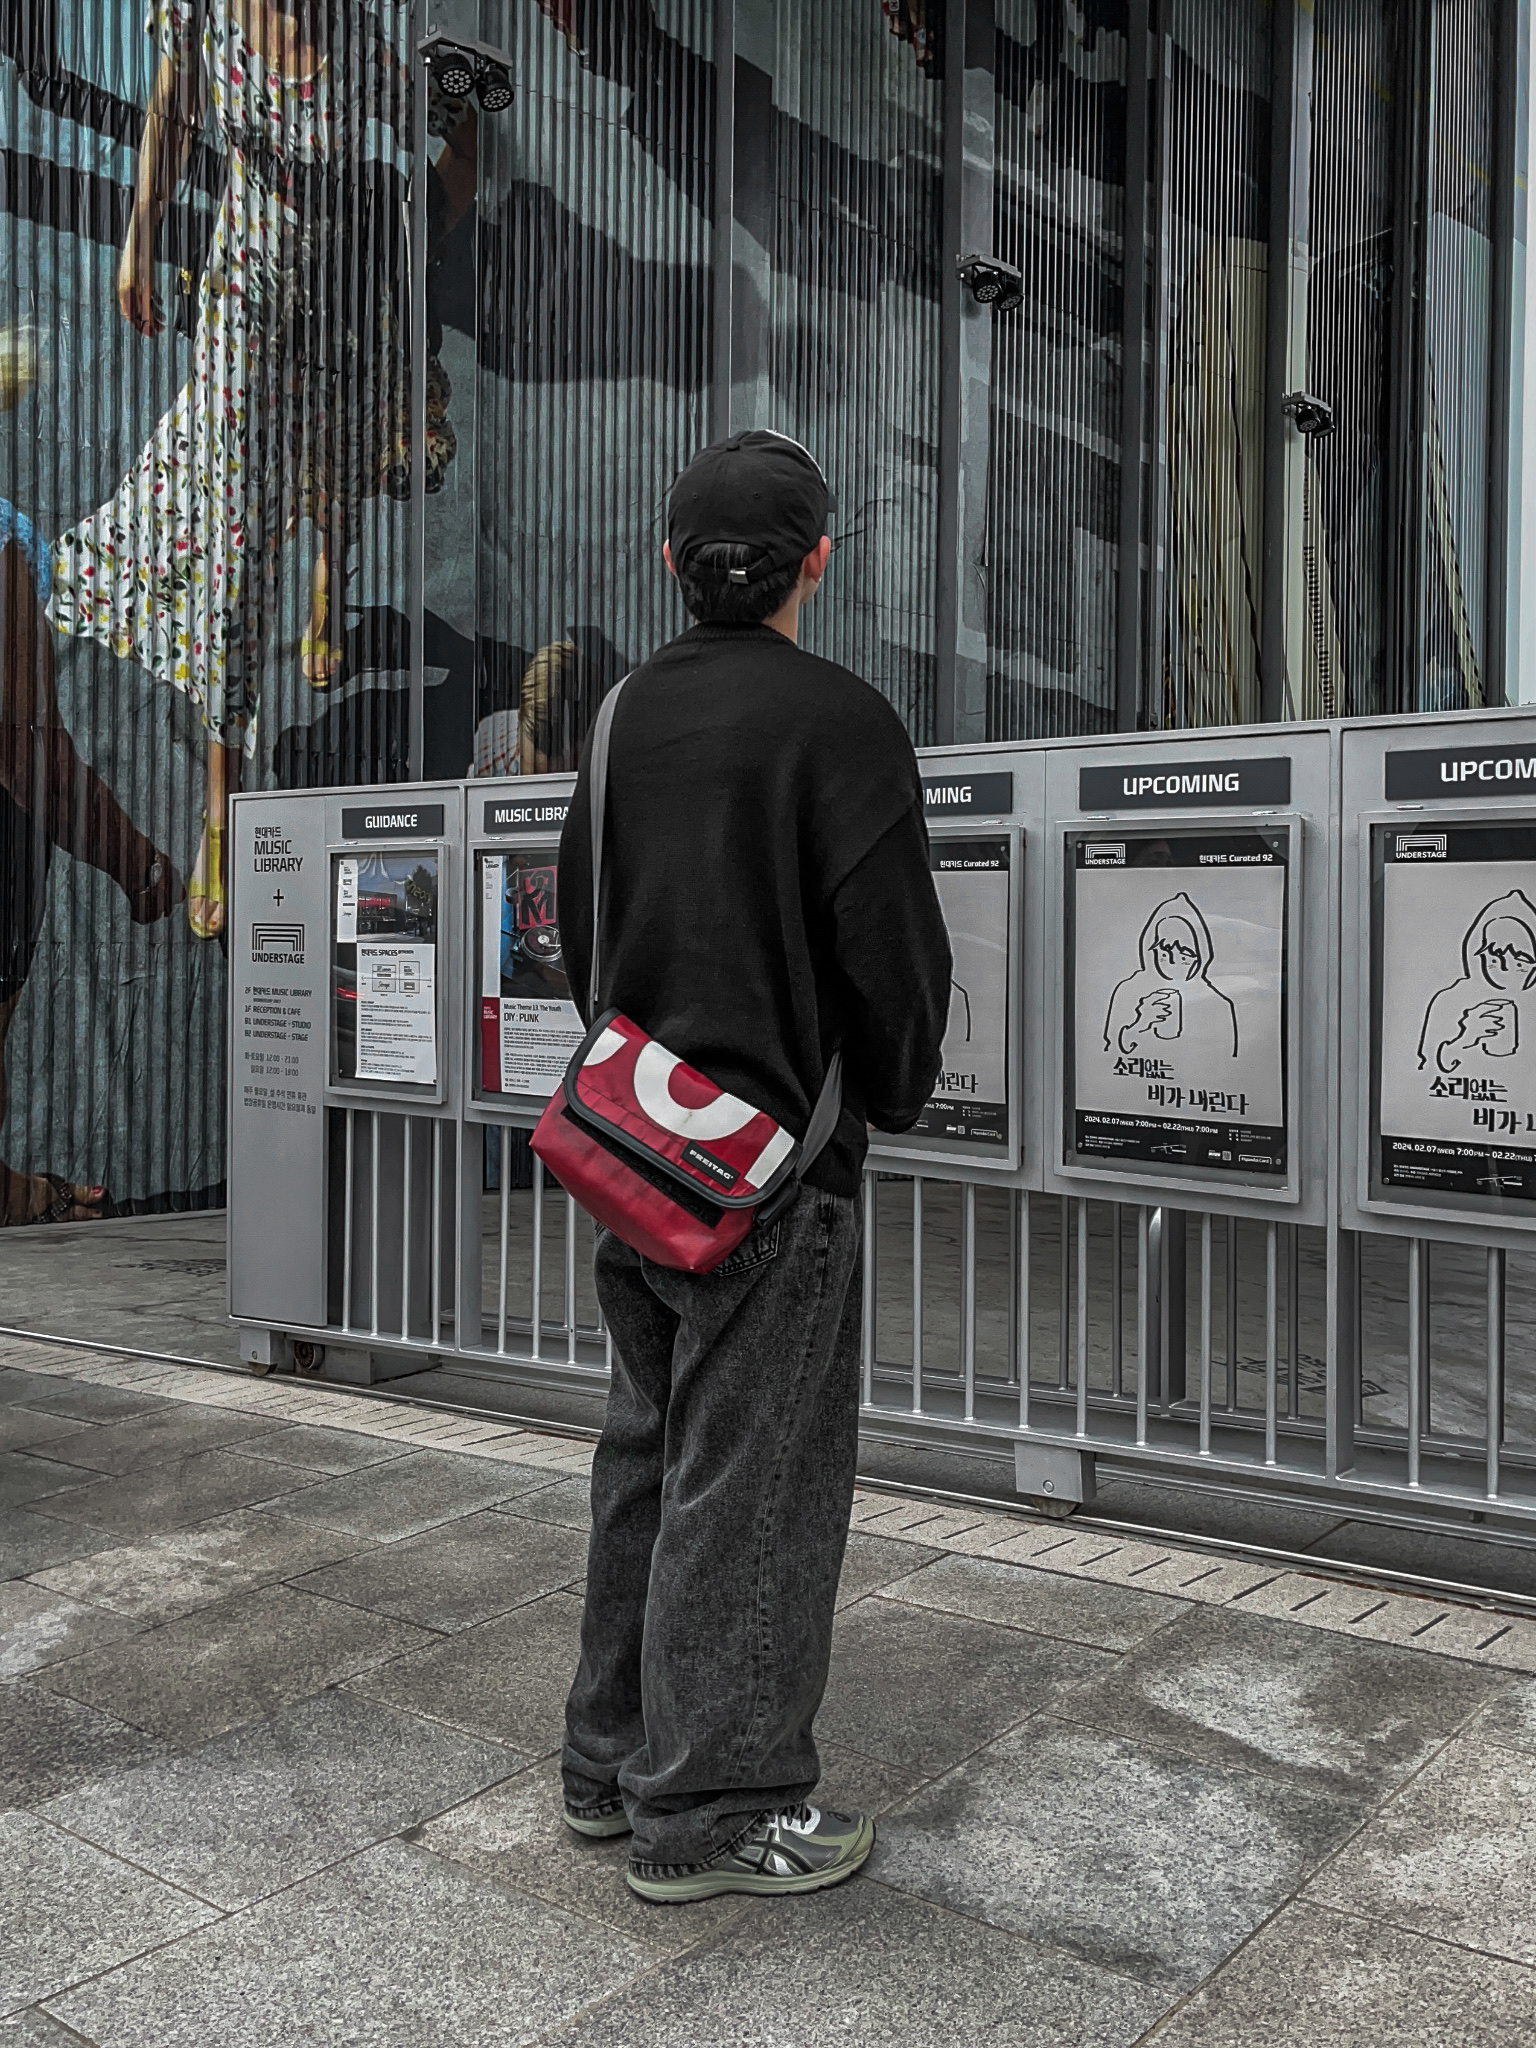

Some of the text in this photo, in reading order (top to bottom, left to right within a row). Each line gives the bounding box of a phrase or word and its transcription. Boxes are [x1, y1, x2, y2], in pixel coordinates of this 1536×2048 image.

[1123, 773, 1240, 796] UPCOMING
[365, 814, 418, 829] GUIDANCE
[494, 808, 532, 824] MUSIC
[254, 826, 282, 839] 현대카드
[254, 839, 292, 855] MUSIC
[254, 857, 303, 873] LIBRARY
[963, 860, 990, 868] Curated
[1229, 854, 1261, 863] Curated
[1262, 853, 1273, 862] 92
[252, 952, 305, 964] UNDERSTAGE
[245, 986, 251, 994] 2F
[272, 988, 288, 996] MUSIC
[290, 989, 312, 997] LIBRARY
[245, 1005, 251, 1013] 1F
[253, 1006, 281, 1014] RECEPTION
[287, 1008, 301, 1016] CAFE
[504, 1012, 516, 1021] DIY
[520, 1013, 539, 1023] PUNK
[253, 1018, 287, 1028] UNDERSTAGE
[292, 1021, 312, 1030] STUDIO
[245, 1030, 251, 1038] B2
[253, 1031, 287, 1040] UNDERSTAGE
[292, 1033, 308, 1042] STAGE
[1113, 1056, 1175, 1080] 소리없는
[1429, 1076, 1508, 1103] 소리없는
[1148, 1085, 1250, 1115] 비가 내린다
[1473, 1107, 1522, 1134] 비가
[1456, 1147, 1484, 1157] 7:00PM
[689, 1149, 733, 1180] FREITAG
